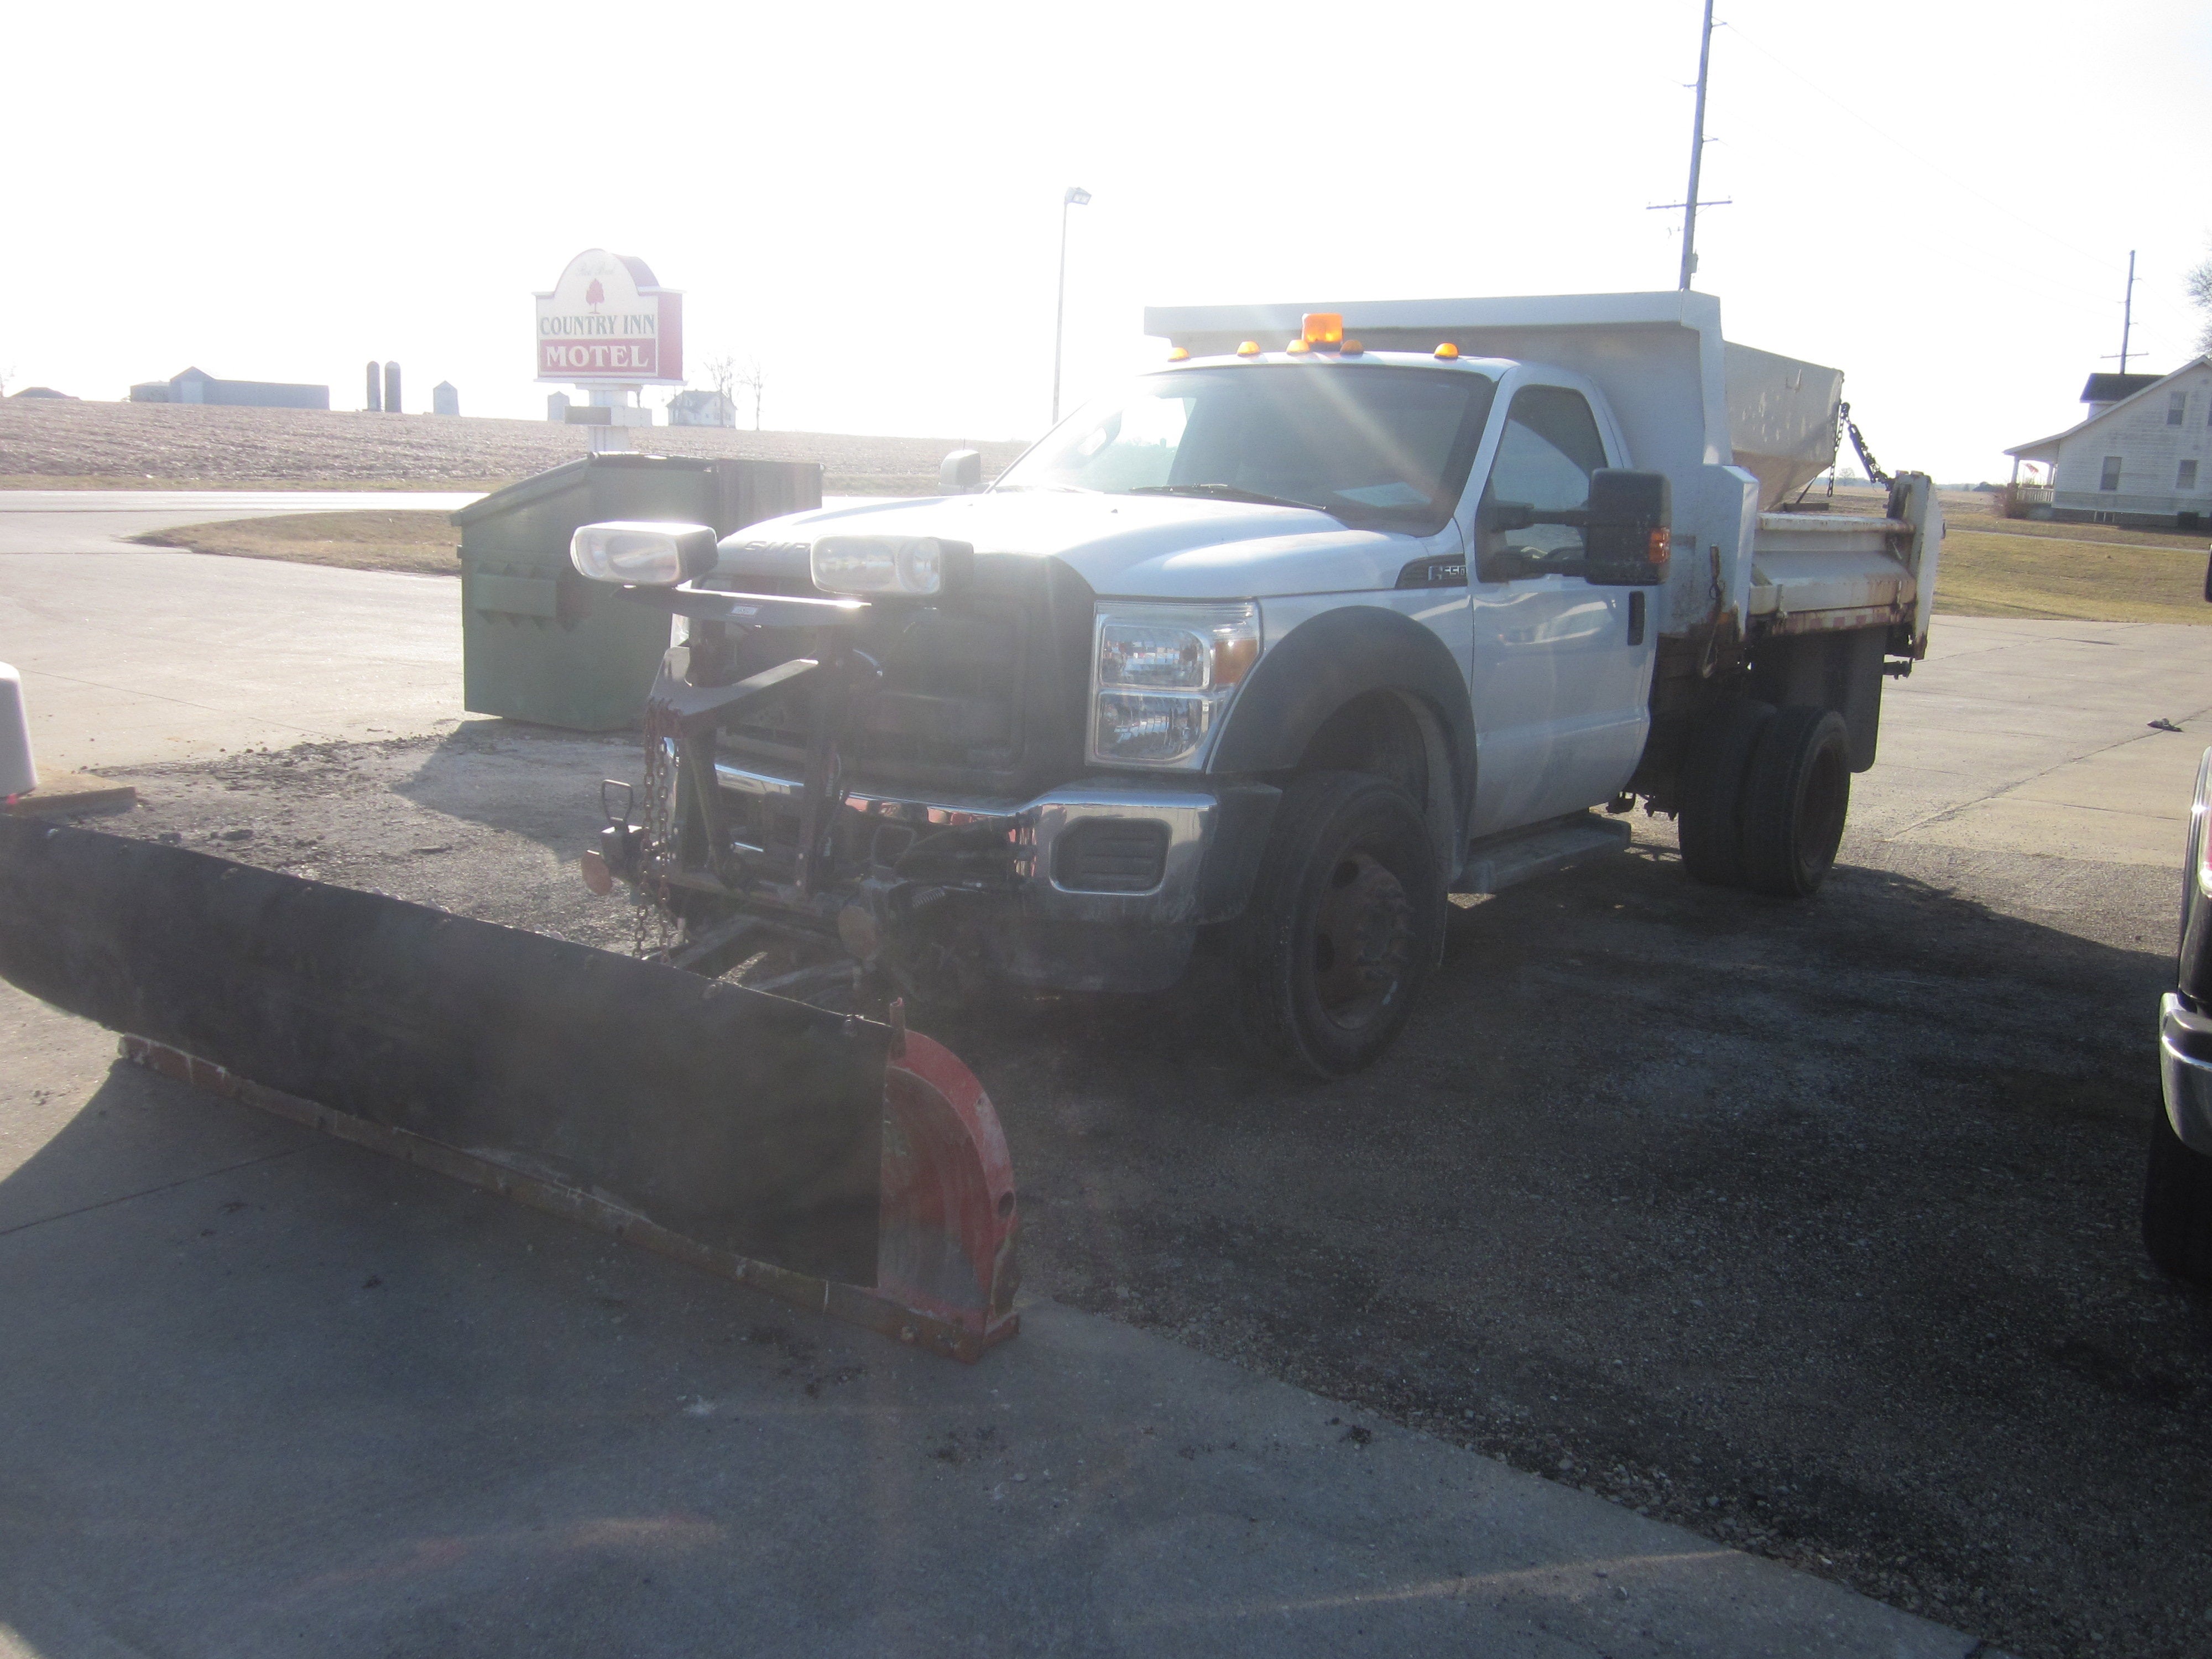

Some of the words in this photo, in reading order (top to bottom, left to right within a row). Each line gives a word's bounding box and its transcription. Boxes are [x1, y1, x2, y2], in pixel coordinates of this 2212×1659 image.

[540, 315, 617, 335] COUNTRY
[623, 314, 655, 335] INN
[546, 345, 649, 367] MOTEL
